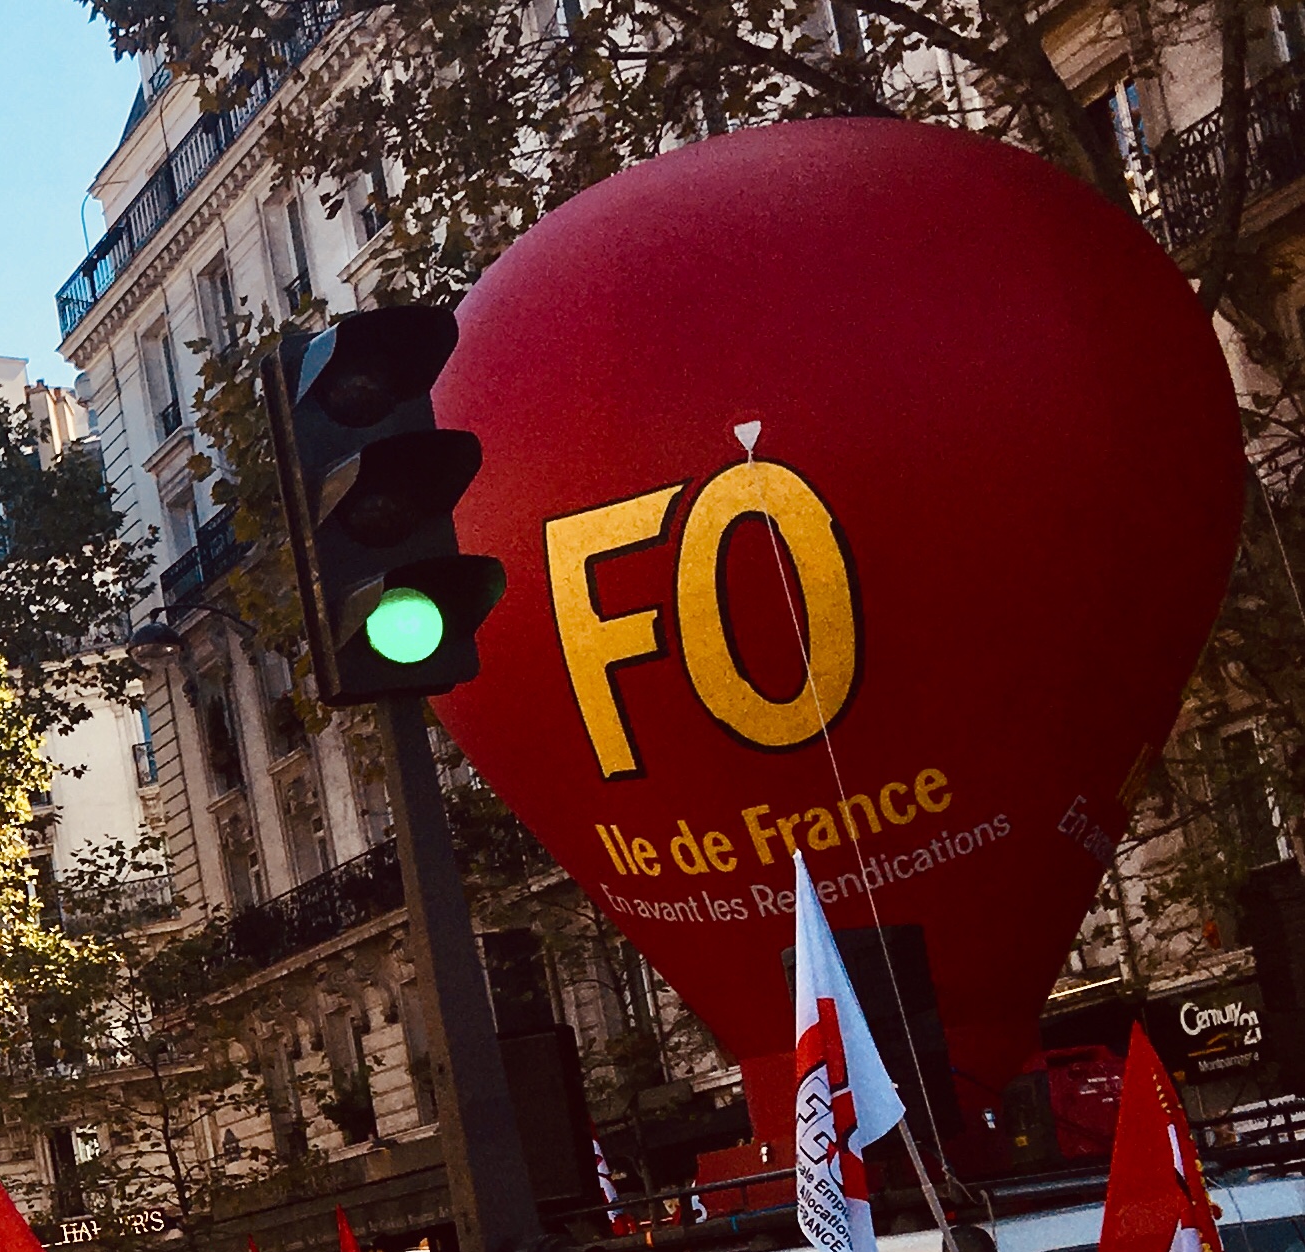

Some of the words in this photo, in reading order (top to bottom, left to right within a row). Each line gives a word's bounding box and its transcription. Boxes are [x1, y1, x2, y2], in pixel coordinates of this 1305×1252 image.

[544, 455, 863, 782] FO
[595, 823, 662, 877] Ile
[670, 819, 739, 875] de
[741, 767, 953, 866] France
[633, 896, 704, 922] avant
[701, 891, 749, 921] les
[749, 813, 1013, 918] Reendications
